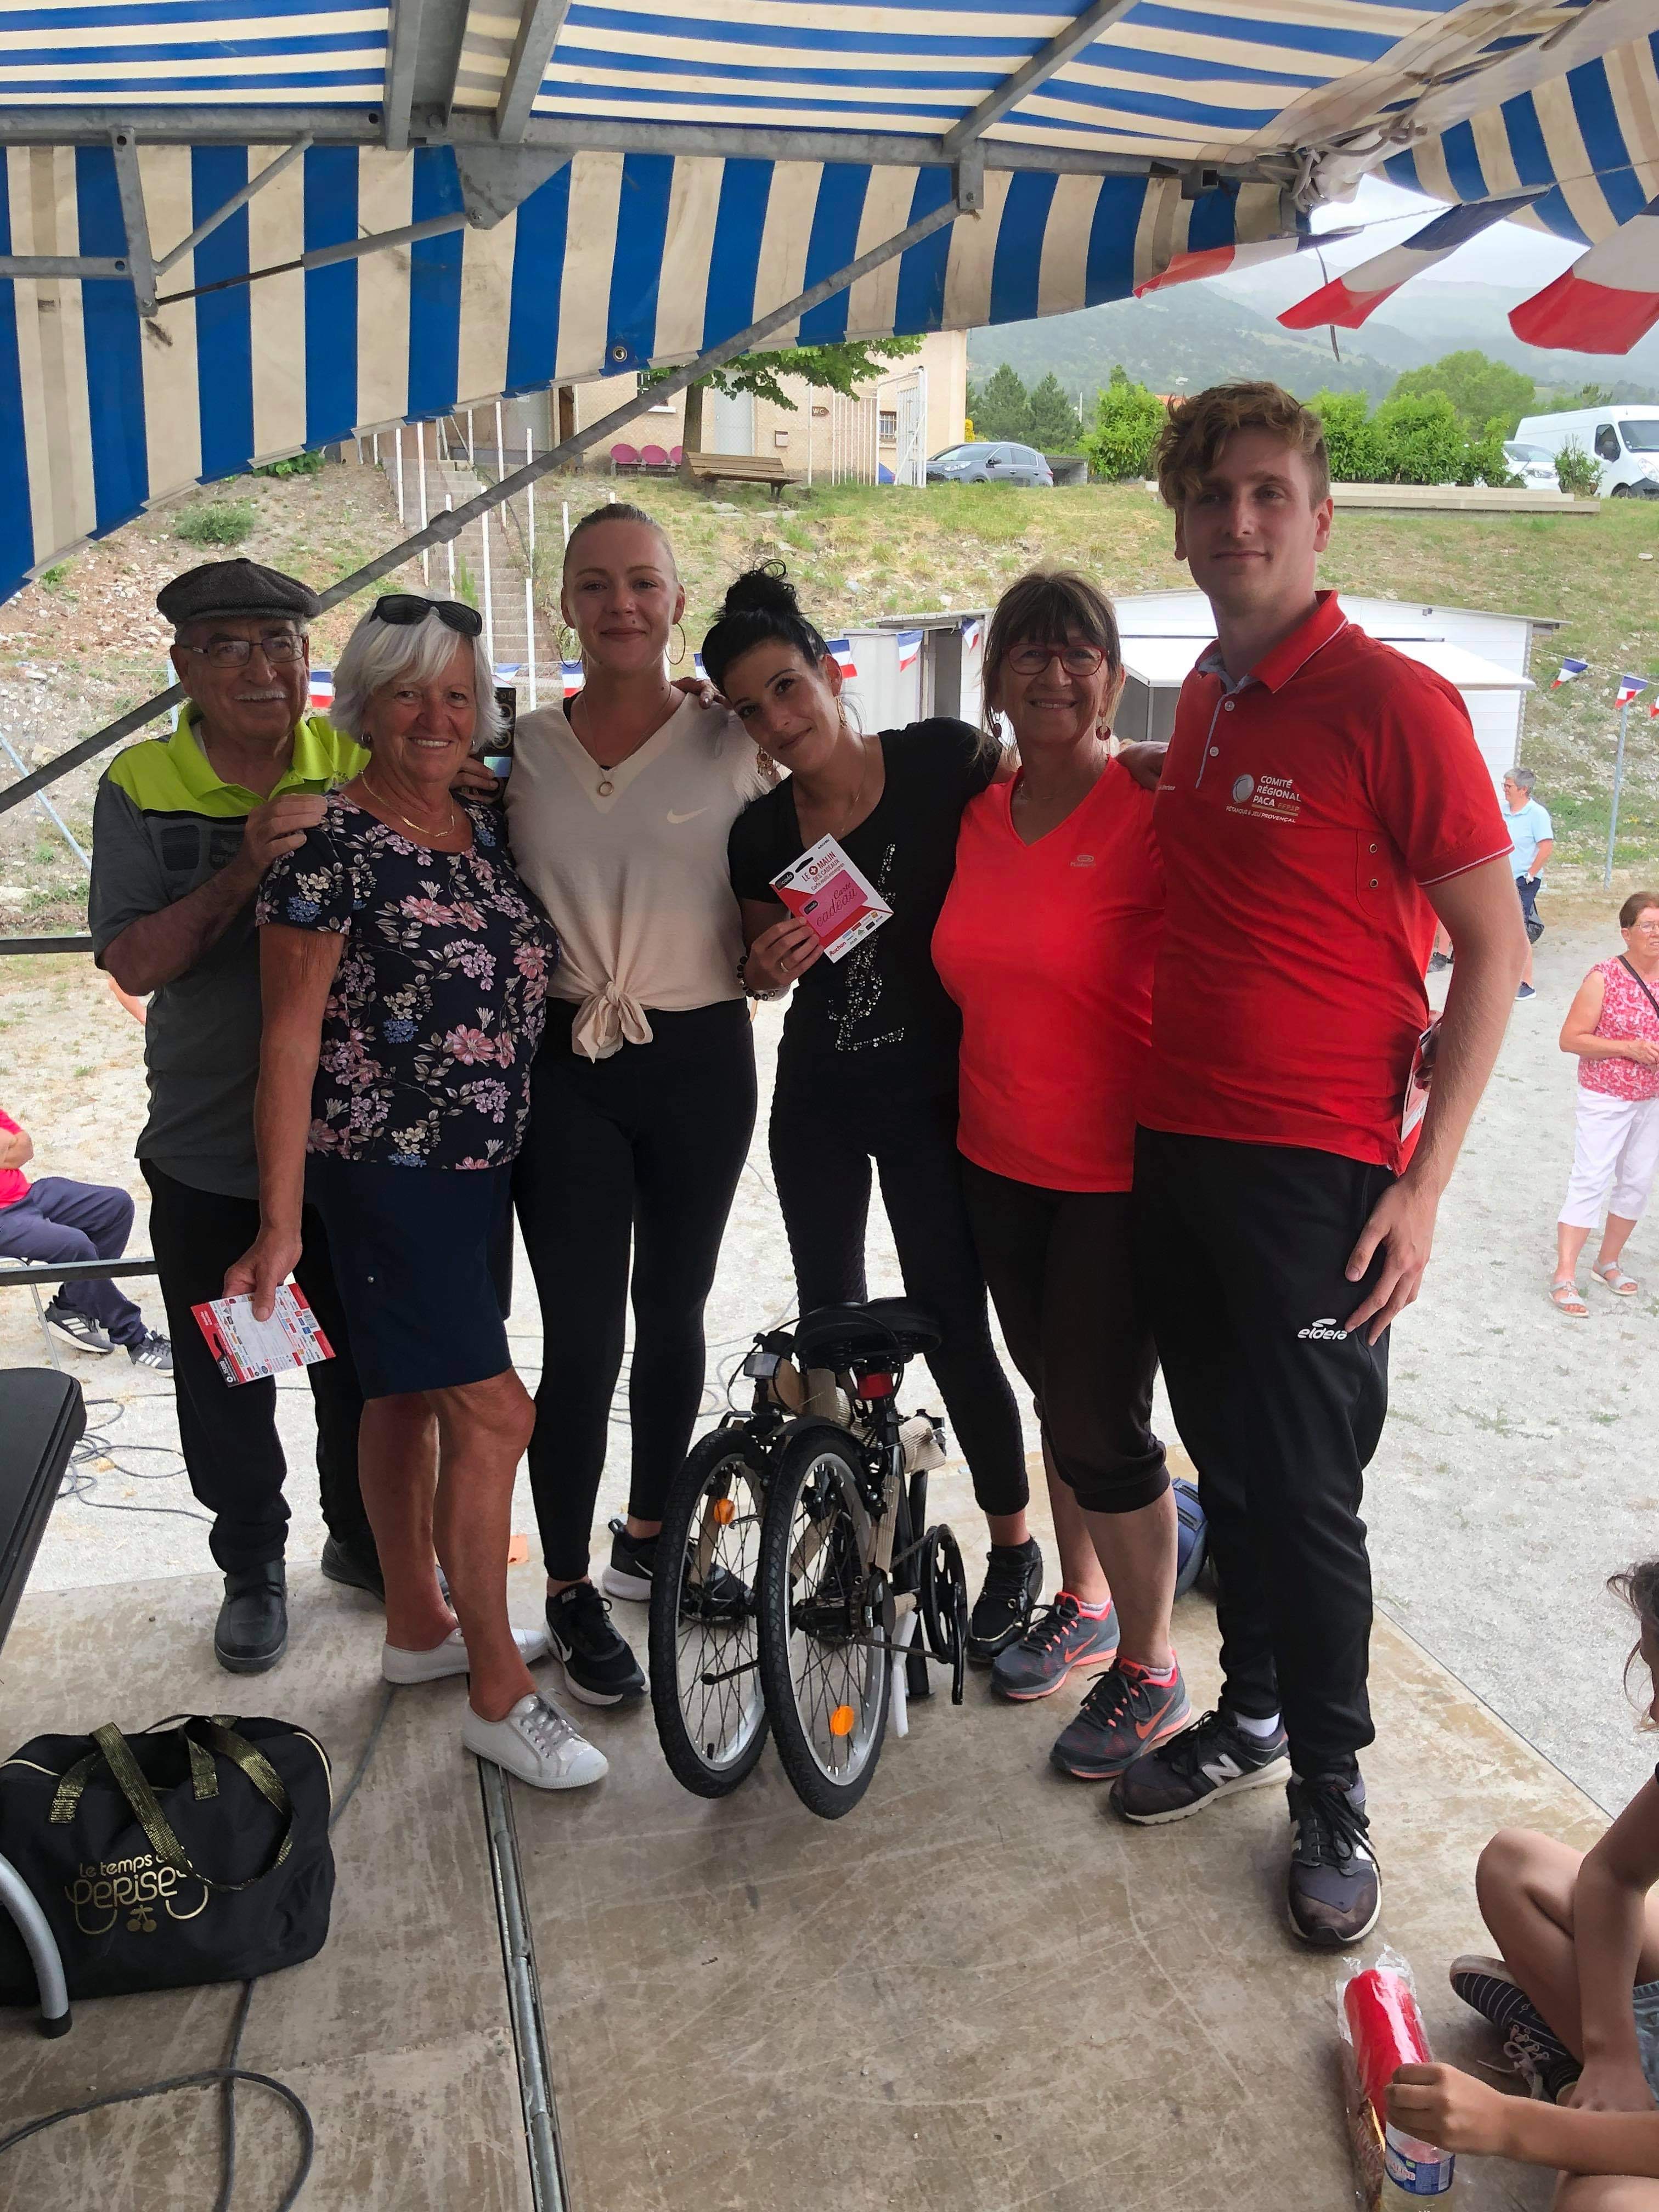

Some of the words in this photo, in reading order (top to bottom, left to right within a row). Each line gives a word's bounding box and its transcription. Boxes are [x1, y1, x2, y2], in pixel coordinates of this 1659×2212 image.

[1261, 775, 1293, 789] COMITÉ
[1252, 795, 1275, 807] PACA
[1256, 785, 1301, 802] RÉGIONAL
[1261, 812, 1296, 823] PROVENÇAL
[802, 872, 811, 882] LE
[817, 851, 836, 869] MALIN
[813, 873, 822, 882] DES
[821, 859, 840, 876] CADEAUX
[817, 888, 856, 927] cadeau
[829, 941, 847, 957] Auchan
[1297, 1328, 1348, 1340] eldera
[100, 1853, 152, 1876] temps
